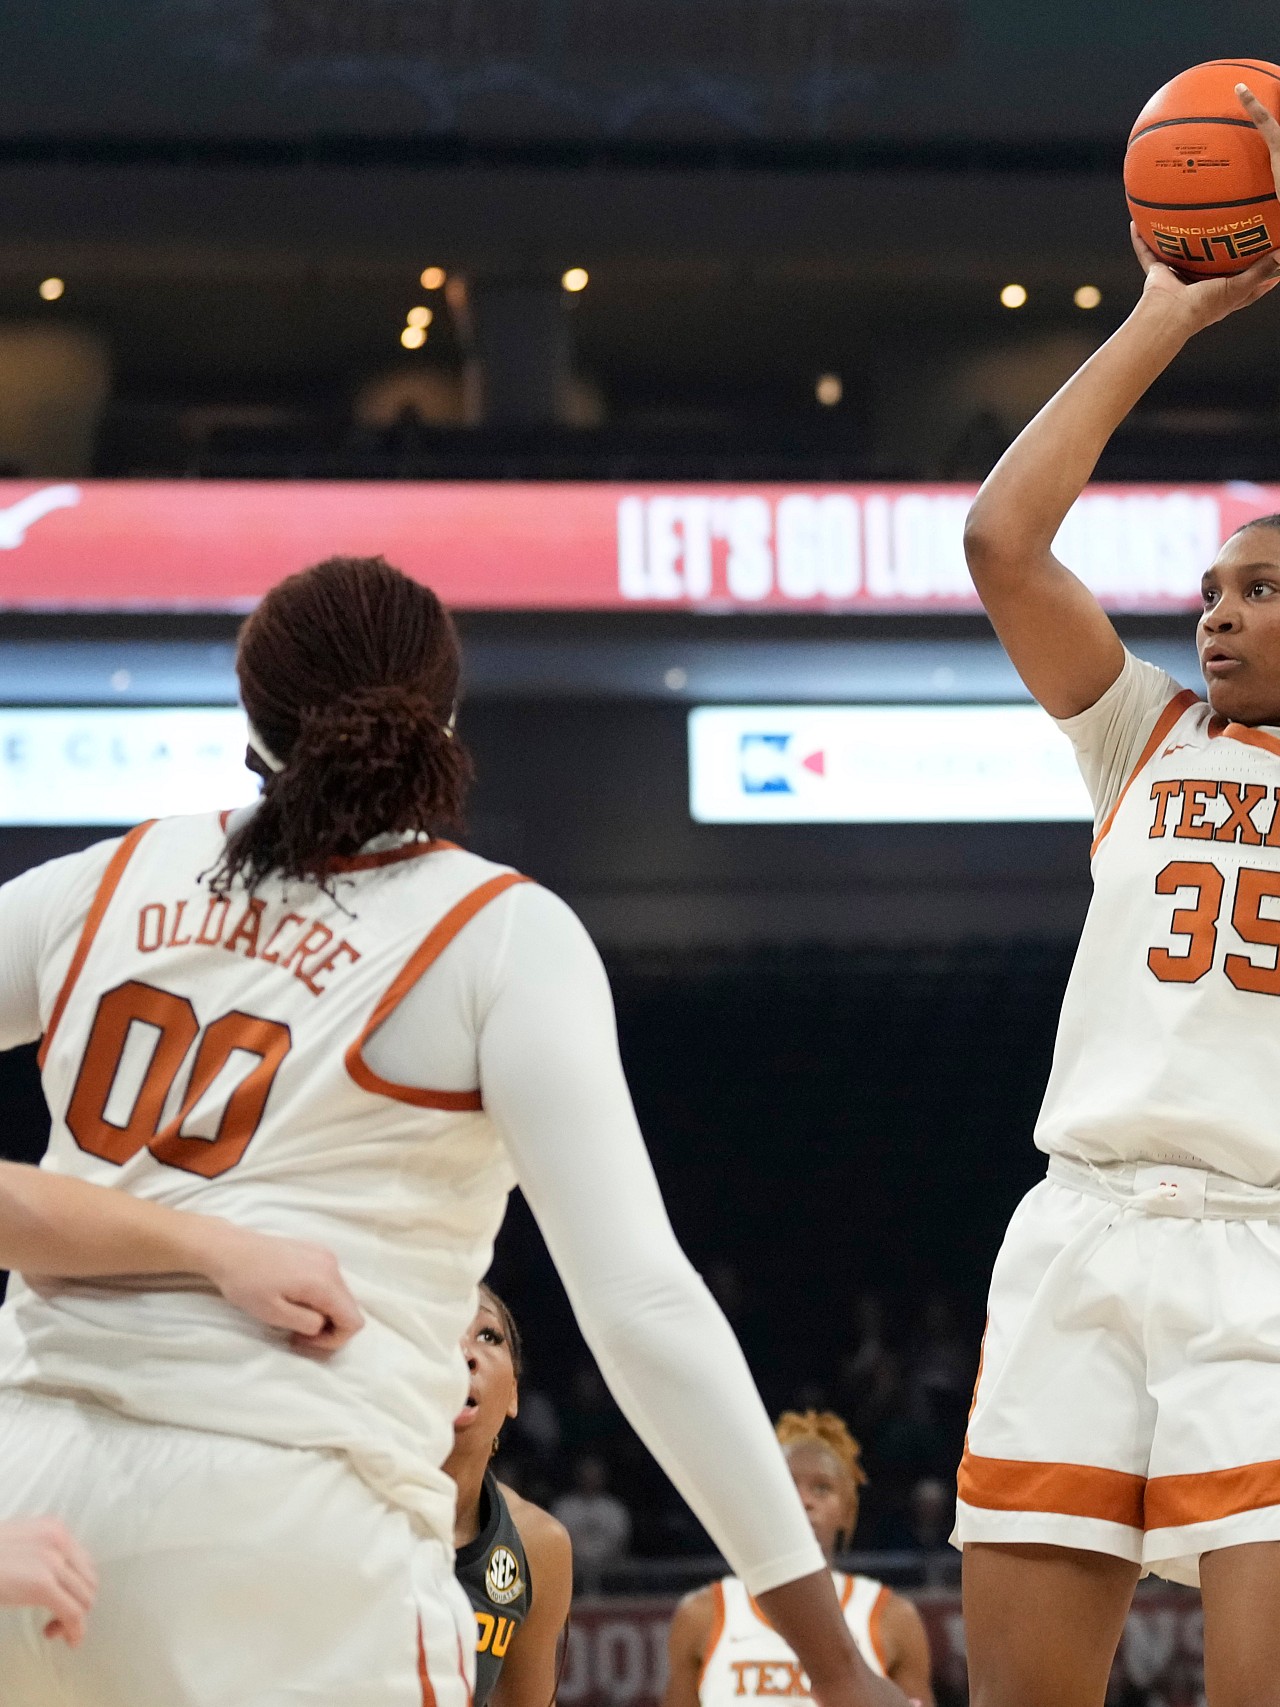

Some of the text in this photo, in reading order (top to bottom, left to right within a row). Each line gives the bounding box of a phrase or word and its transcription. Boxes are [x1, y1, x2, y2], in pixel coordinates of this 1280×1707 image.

[1151, 214, 1264, 236] CHAMPIONSHIP
[1153, 223, 1274, 262] ELITE
[617, 494, 772, 601] LET'S
[777, 494, 862, 601] GO
[137, 896, 361, 998] OLDACRE
[65, 979, 292, 1180] 00
[489, 1548, 516, 1590] SEC
